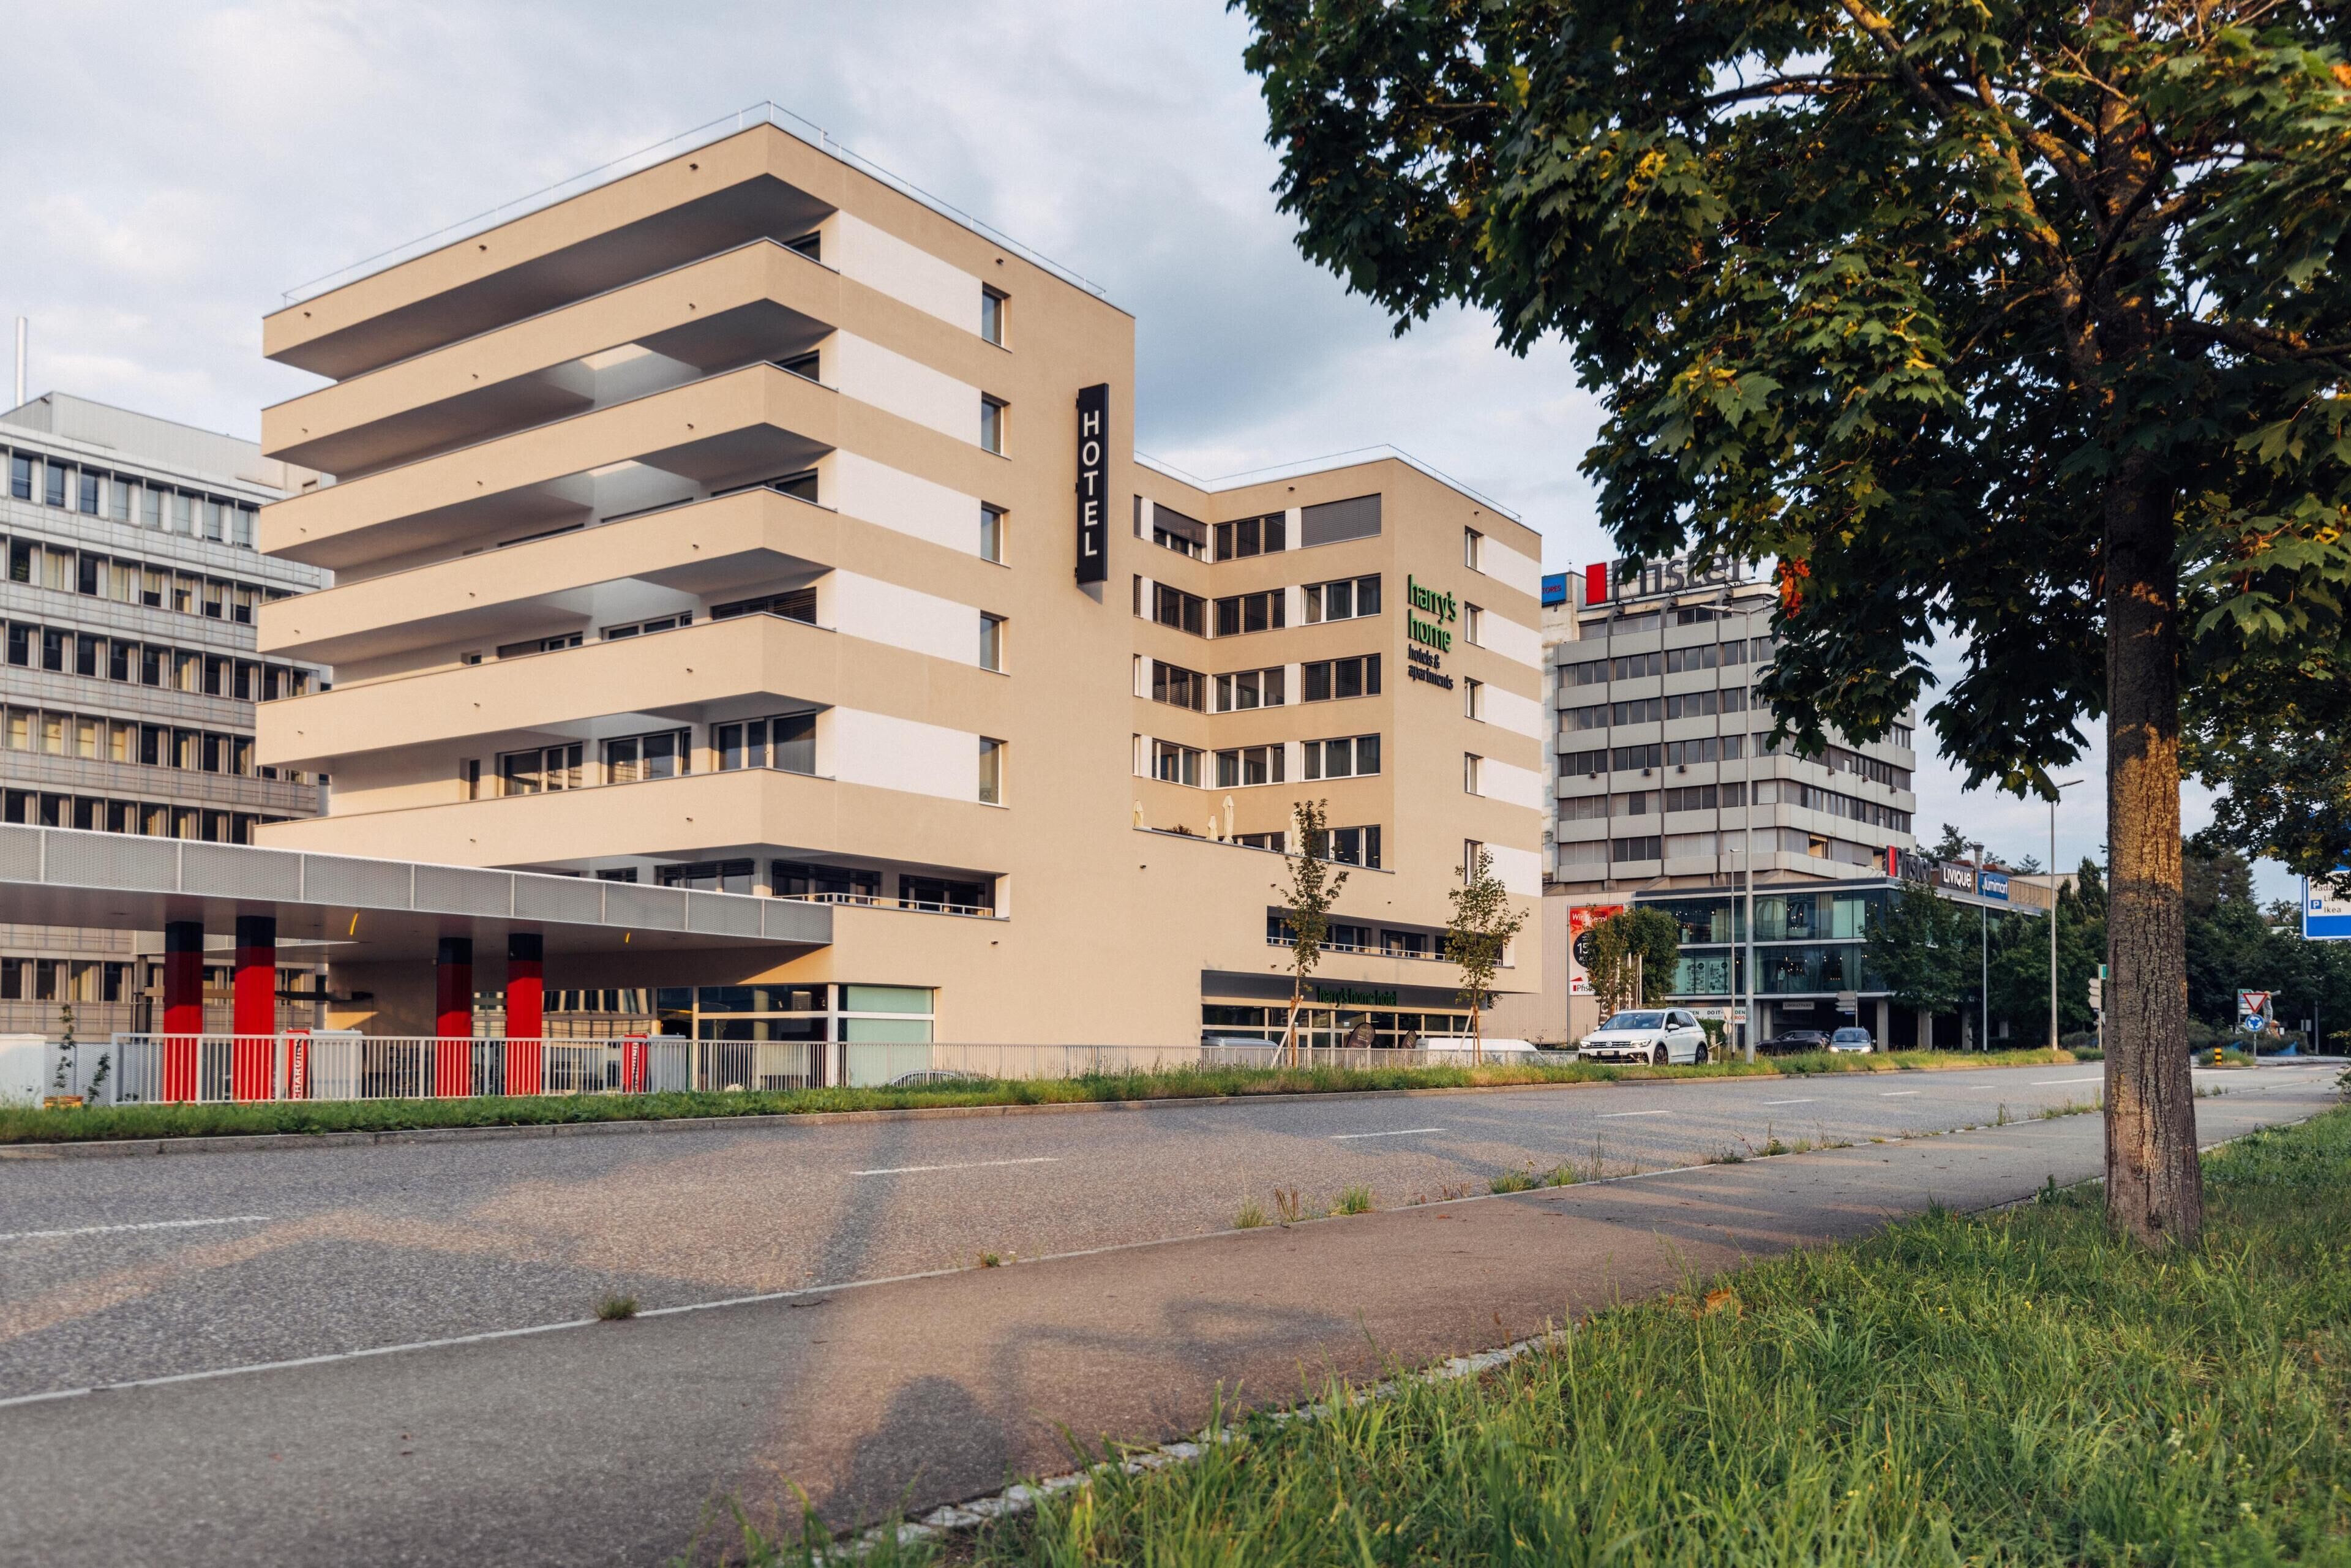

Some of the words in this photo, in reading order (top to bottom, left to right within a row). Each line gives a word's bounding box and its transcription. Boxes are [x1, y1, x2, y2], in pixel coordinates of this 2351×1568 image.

[1082, 410, 1100, 557] HOTEL
[1408, 574, 1457, 625] harry's
[1542, 585, 1562, 594] TORES
[1408, 609, 1452, 653] home
[1408, 643, 1433, 667] hotels
[1434, 654, 1440, 669] &
[1408, 663, 1453, 690] apartments
[1317, 986, 1348, 1008] harry's
[1348, 988, 1375, 1005] home
[1375, 990, 1397, 1006] hotel
